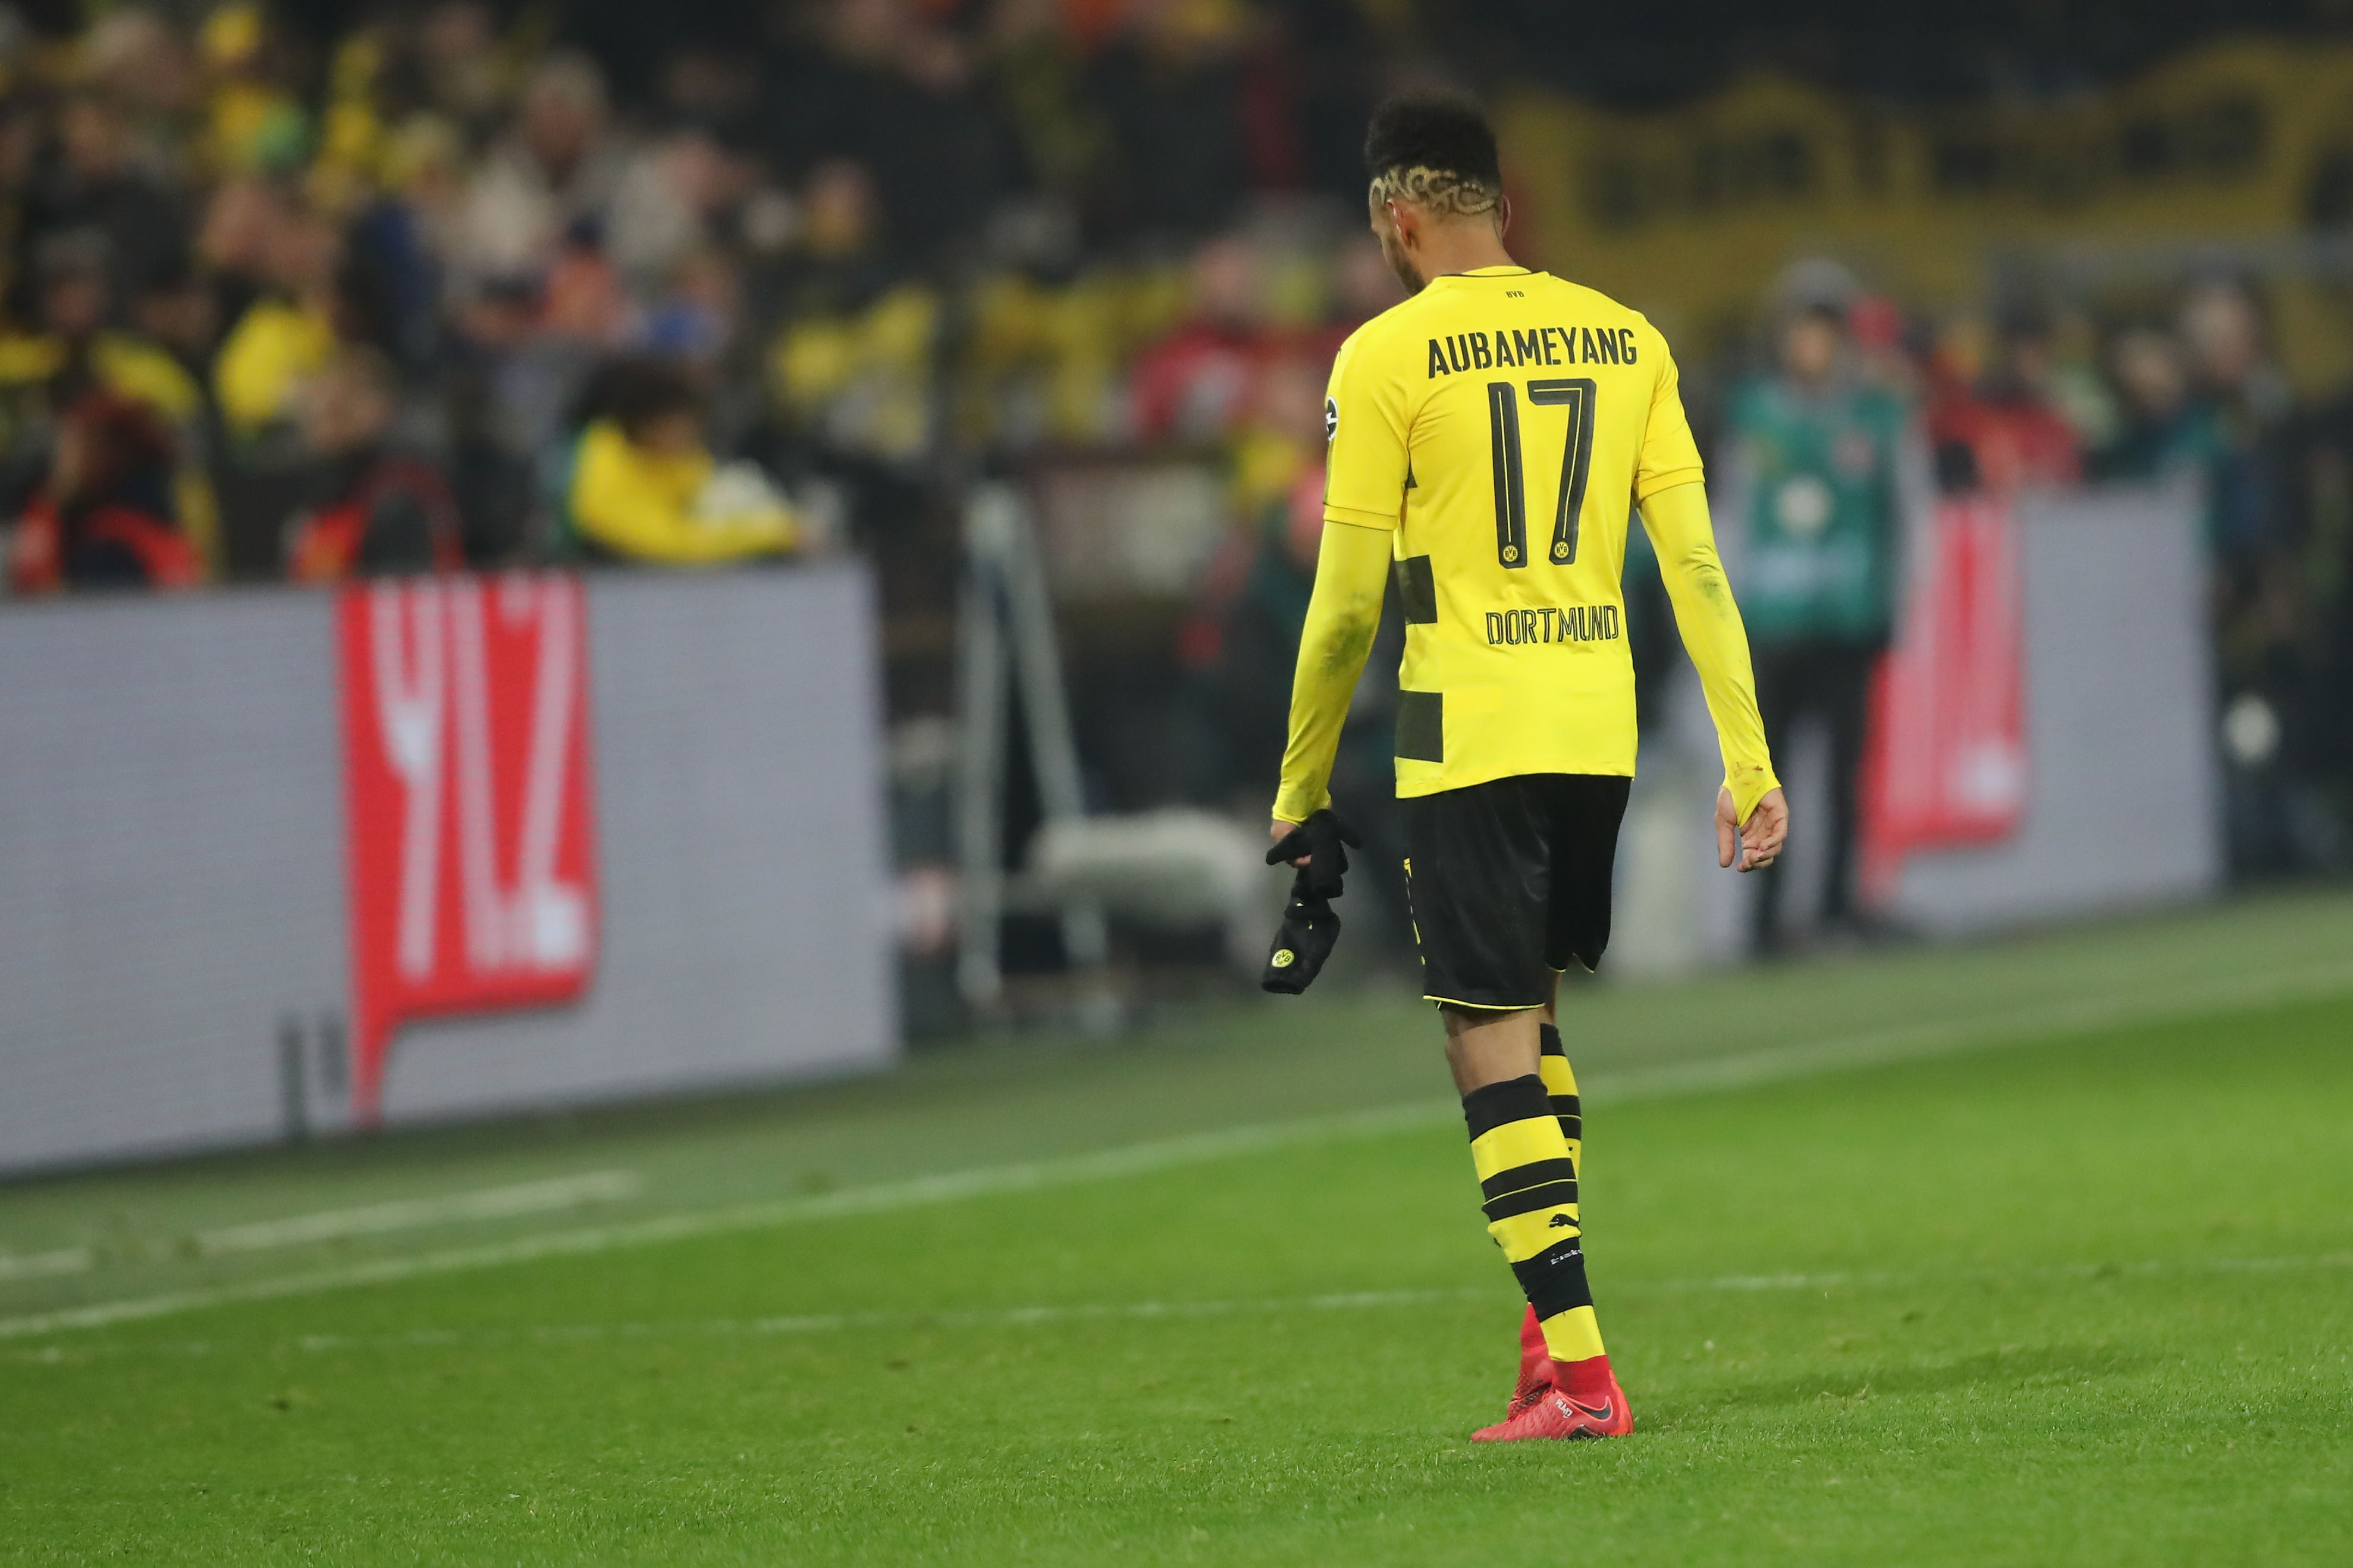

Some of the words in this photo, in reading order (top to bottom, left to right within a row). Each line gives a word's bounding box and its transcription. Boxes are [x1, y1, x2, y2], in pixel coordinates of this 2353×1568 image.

[1428, 327, 1637, 379] AUBAMEYANG
[1487, 378, 1597, 569] 17
[1485, 605, 1619, 645] DORTMUND
